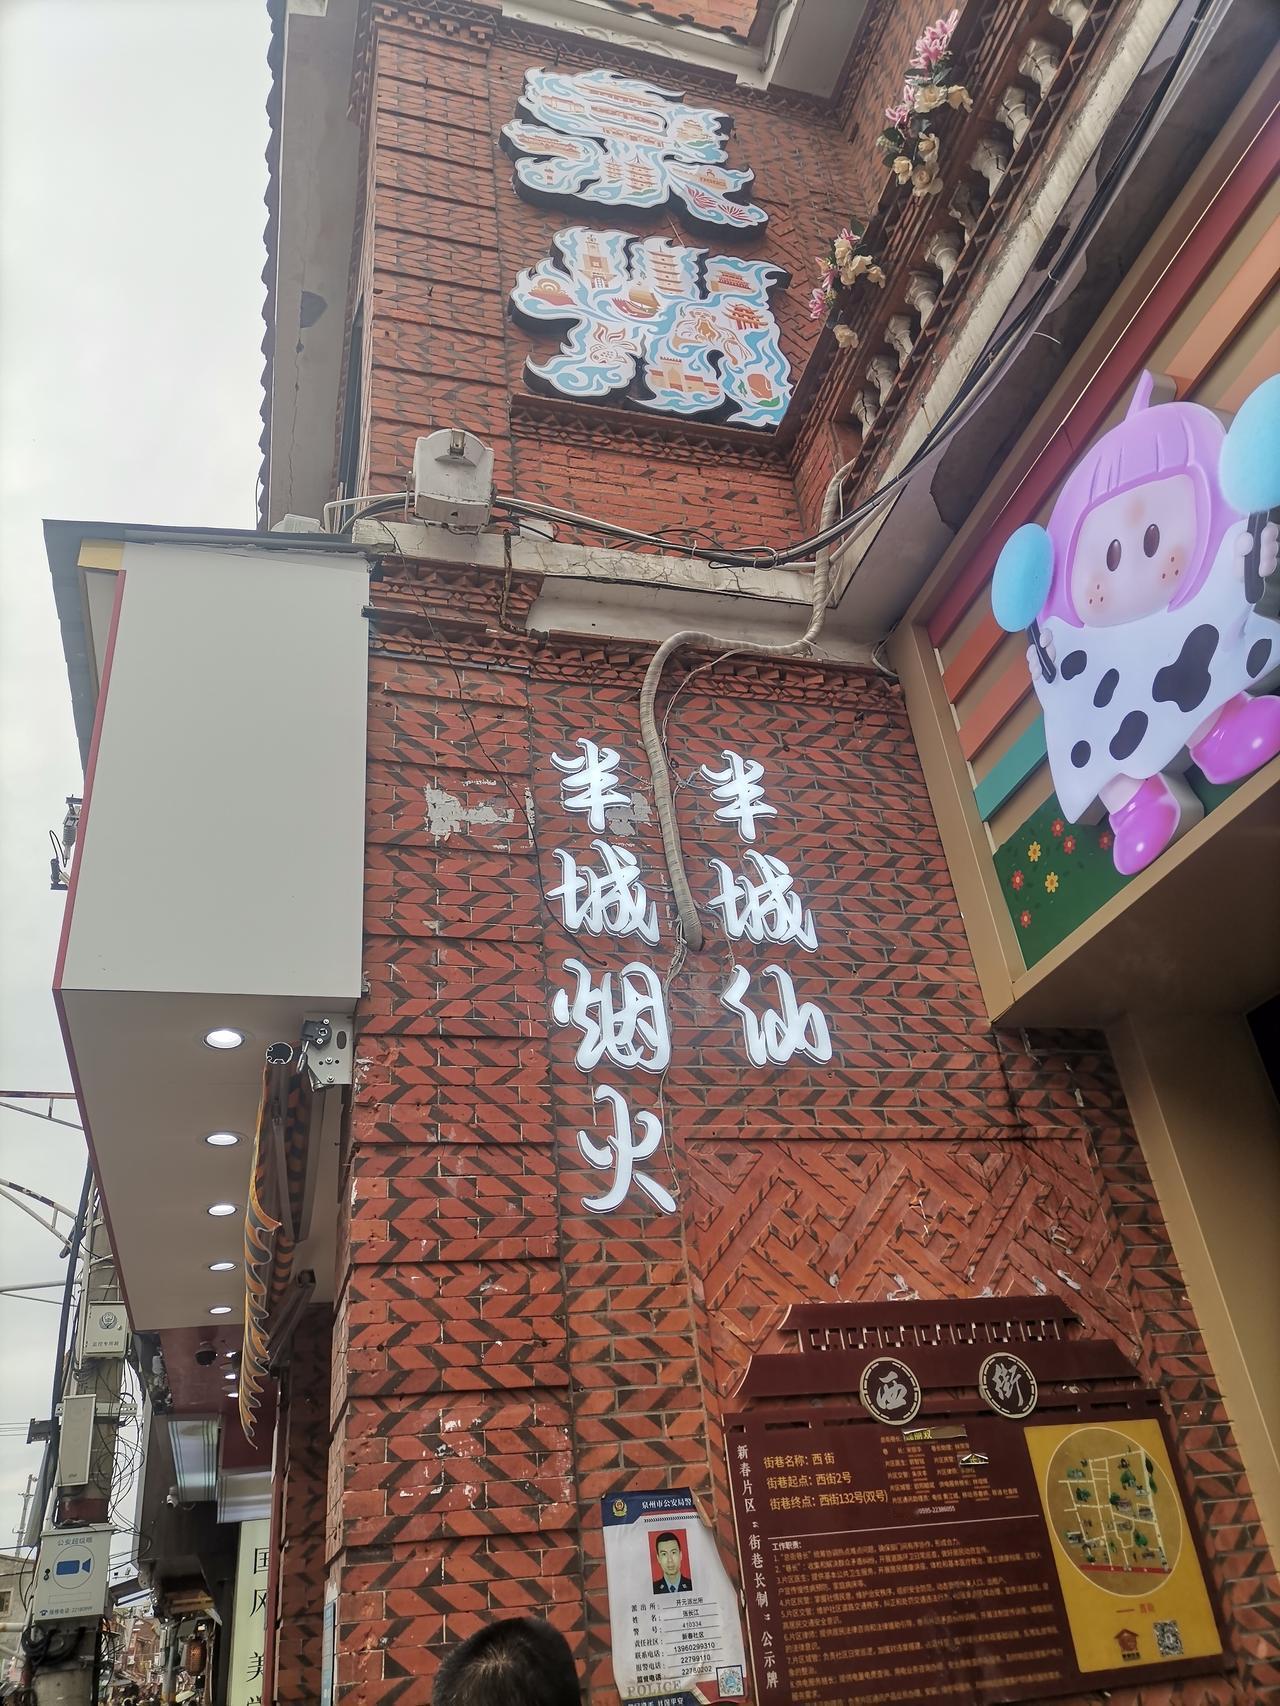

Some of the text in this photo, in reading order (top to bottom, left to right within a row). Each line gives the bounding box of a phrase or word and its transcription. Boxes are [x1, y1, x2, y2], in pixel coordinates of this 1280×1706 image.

[544, 737, 678, 1215] 半城烟火
[699, 749, 834, 1070] 半城仙
[627, 1680, 681, 1697] POLICE
